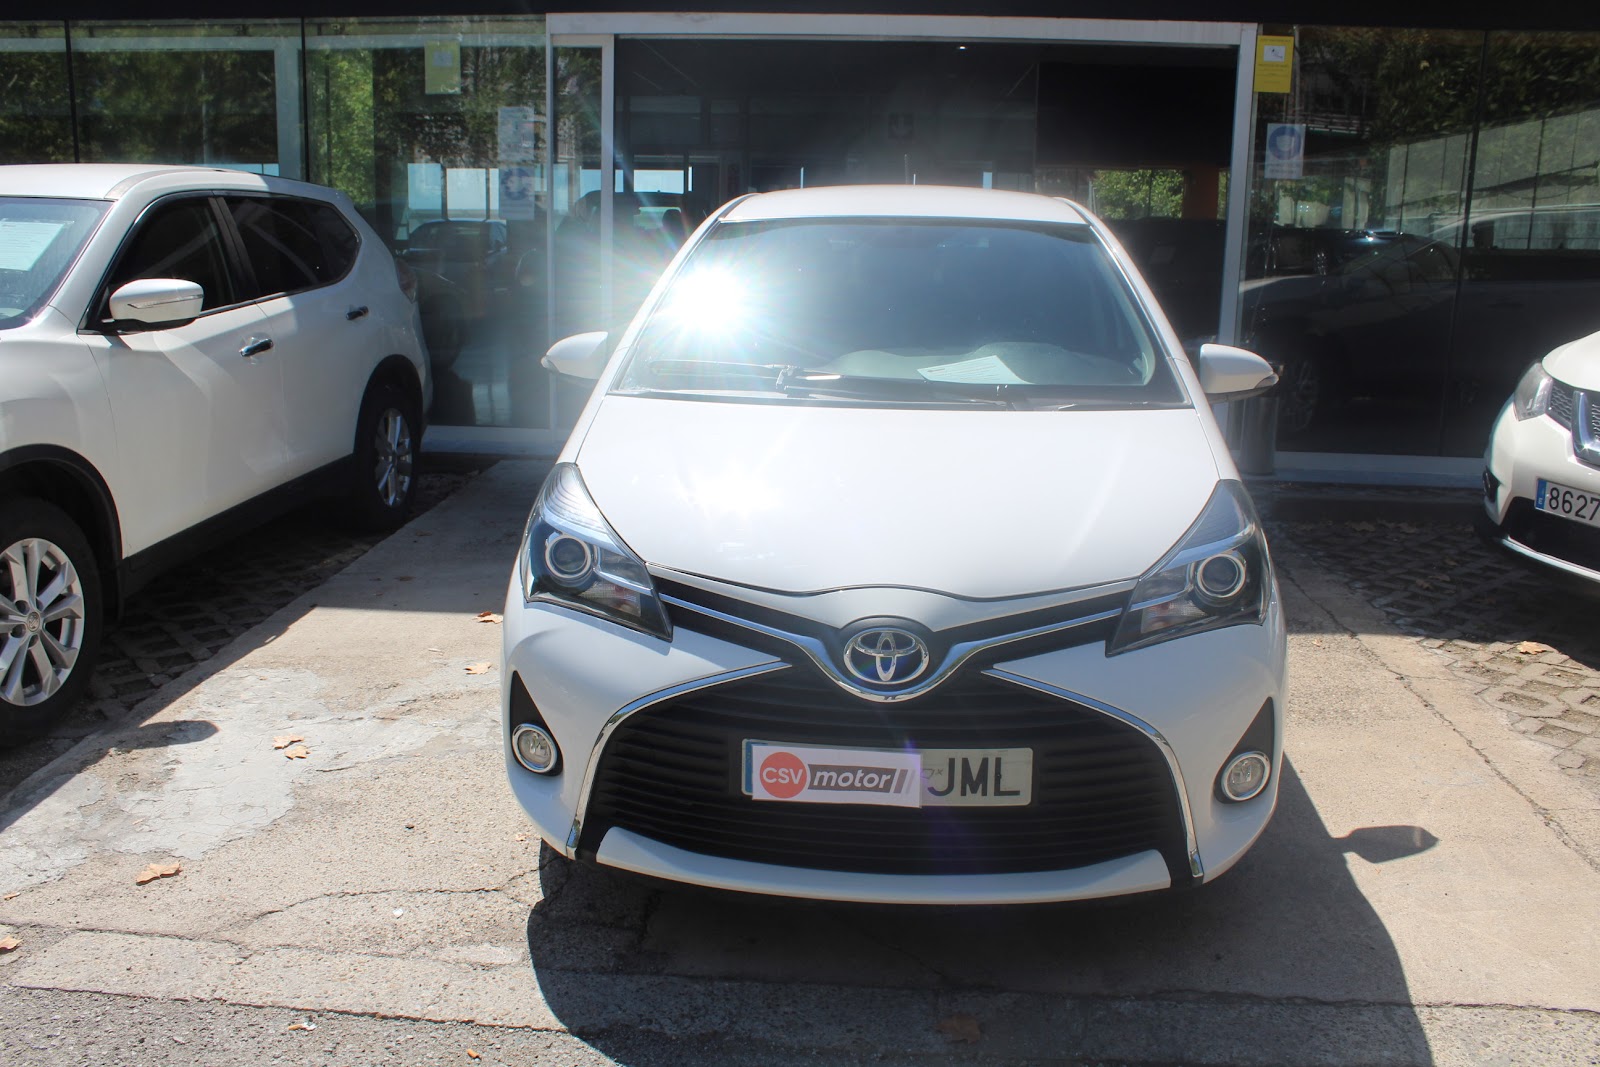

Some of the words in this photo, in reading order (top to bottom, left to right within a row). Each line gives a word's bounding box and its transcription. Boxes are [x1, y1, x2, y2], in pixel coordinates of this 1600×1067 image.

[1549, 487, 1600, 520] 8627
[762, 766, 804, 786] CSV
[813, 769, 893, 789] motor
[927, 756, 1021, 797] JML
